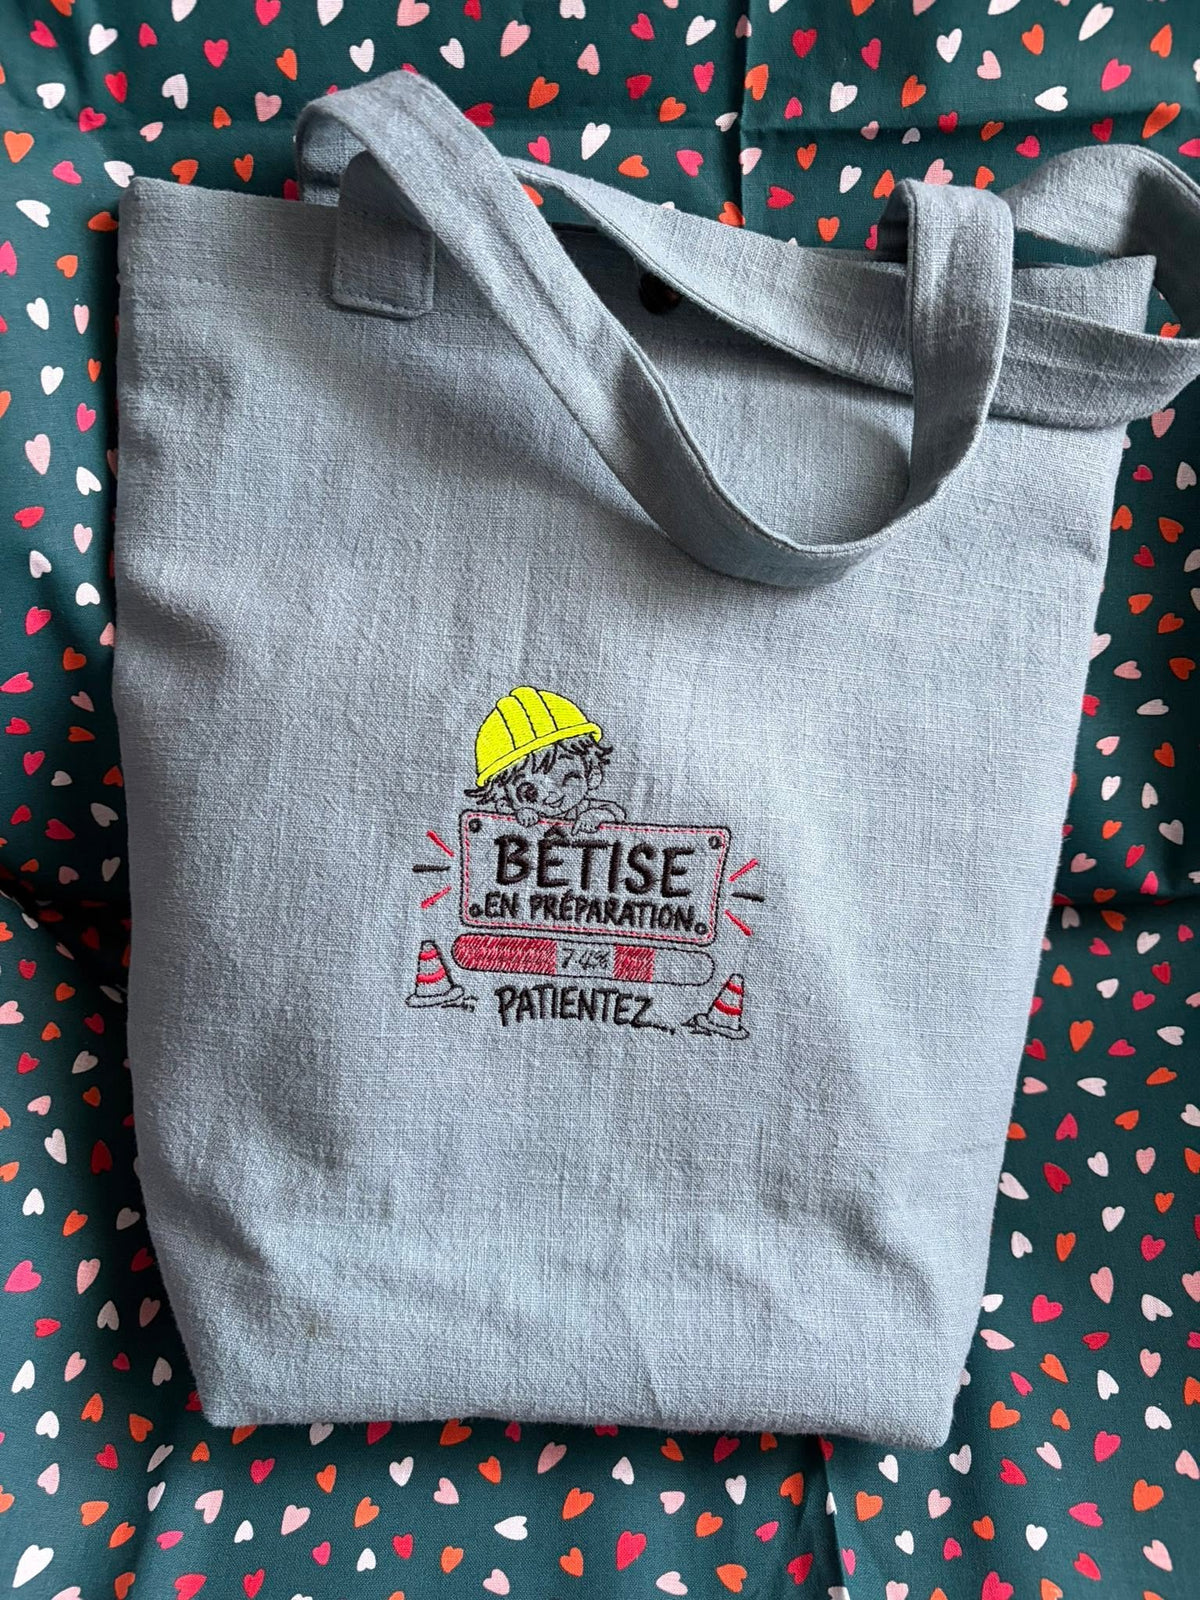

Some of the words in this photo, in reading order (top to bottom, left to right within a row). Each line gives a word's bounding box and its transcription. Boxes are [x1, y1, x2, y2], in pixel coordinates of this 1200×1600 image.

[494, 826, 695, 898] BÊTISE
[485, 891, 520, 919] EN
[529, 889, 695, 932] PRÉPARATION
